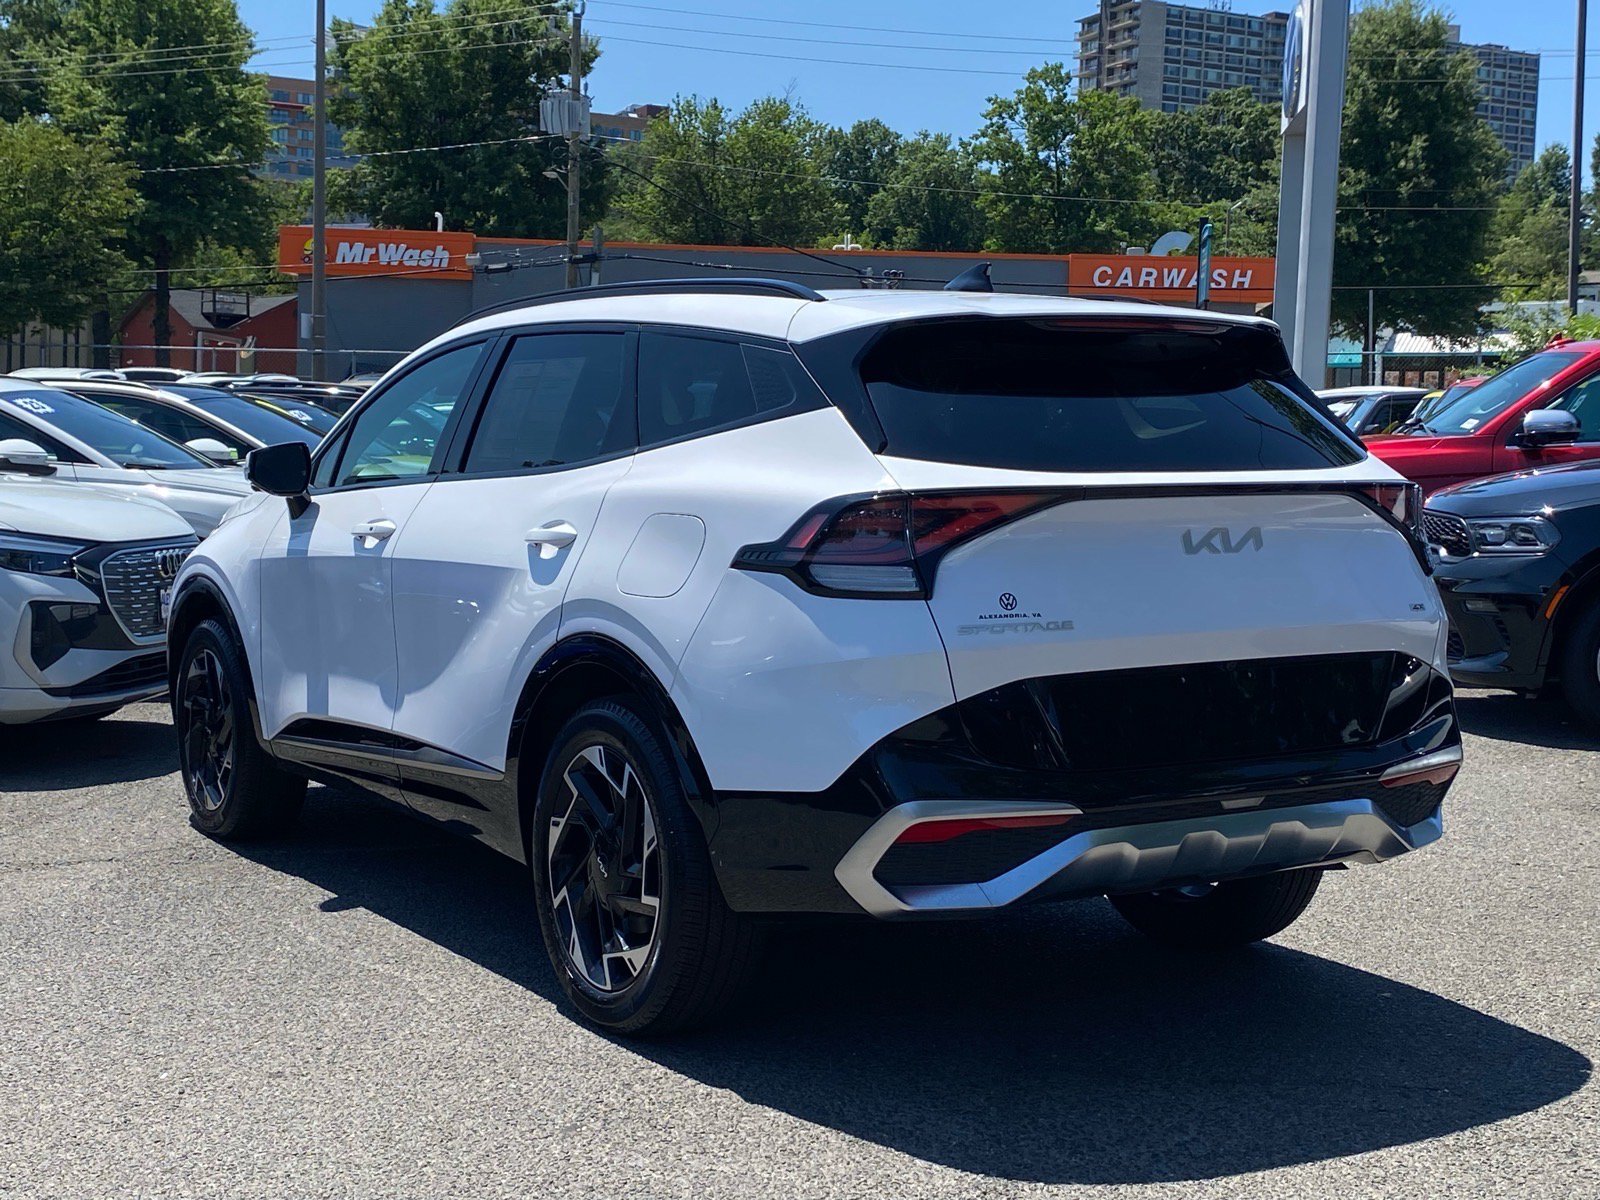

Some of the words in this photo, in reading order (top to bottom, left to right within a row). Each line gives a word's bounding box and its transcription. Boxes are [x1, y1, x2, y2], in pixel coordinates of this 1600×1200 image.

[335, 242, 376, 265] Mr
[378, 243, 450, 267] Wash
[1182, 527, 1263, 555] KIA
[957, 620, 1074, 636] SPORTAGE
